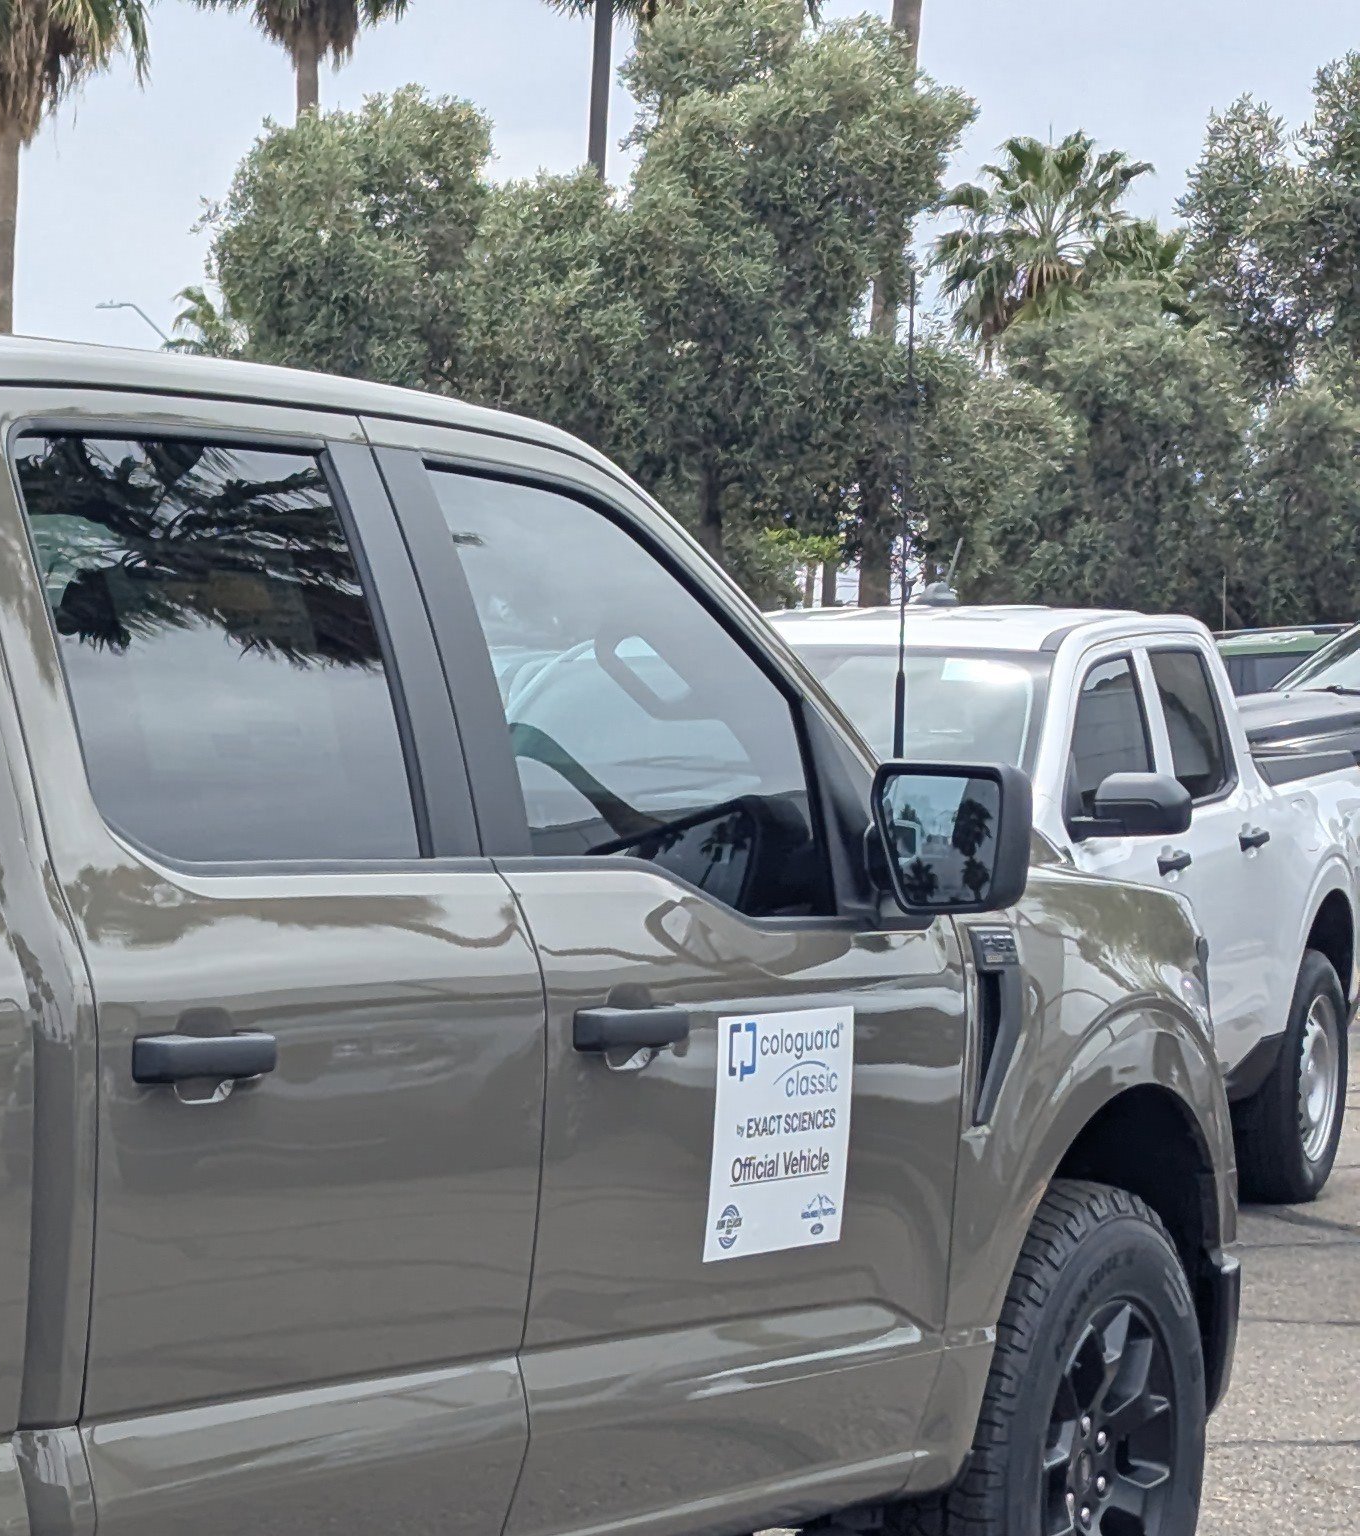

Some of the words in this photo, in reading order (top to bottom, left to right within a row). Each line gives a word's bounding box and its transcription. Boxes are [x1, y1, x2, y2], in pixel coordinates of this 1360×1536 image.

[785, 1069, 838, 1098] classic
[746, 1114, 782, 1139] EXACT
[783, 1107, 836, 1134] SCIENCES
[731, 1152, 780, 1183] Official
[782, 1146, 830, 1176] Vehicle
